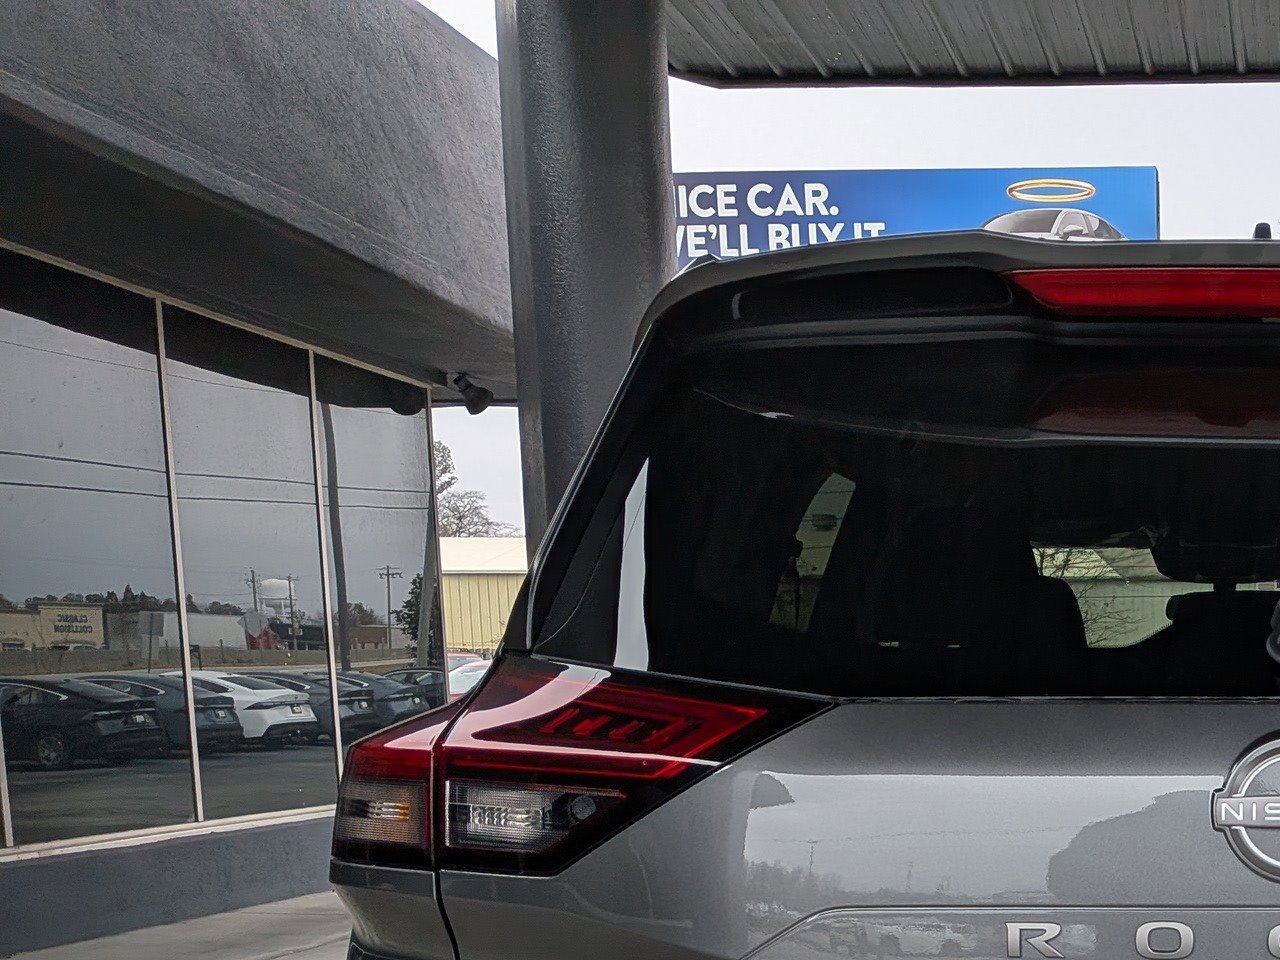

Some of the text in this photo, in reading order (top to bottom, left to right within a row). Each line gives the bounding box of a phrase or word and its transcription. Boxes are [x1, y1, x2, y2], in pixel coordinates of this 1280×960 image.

[673, 183, 839, 218] ICE CAR.
[768, 222, 845, 251] BUY
